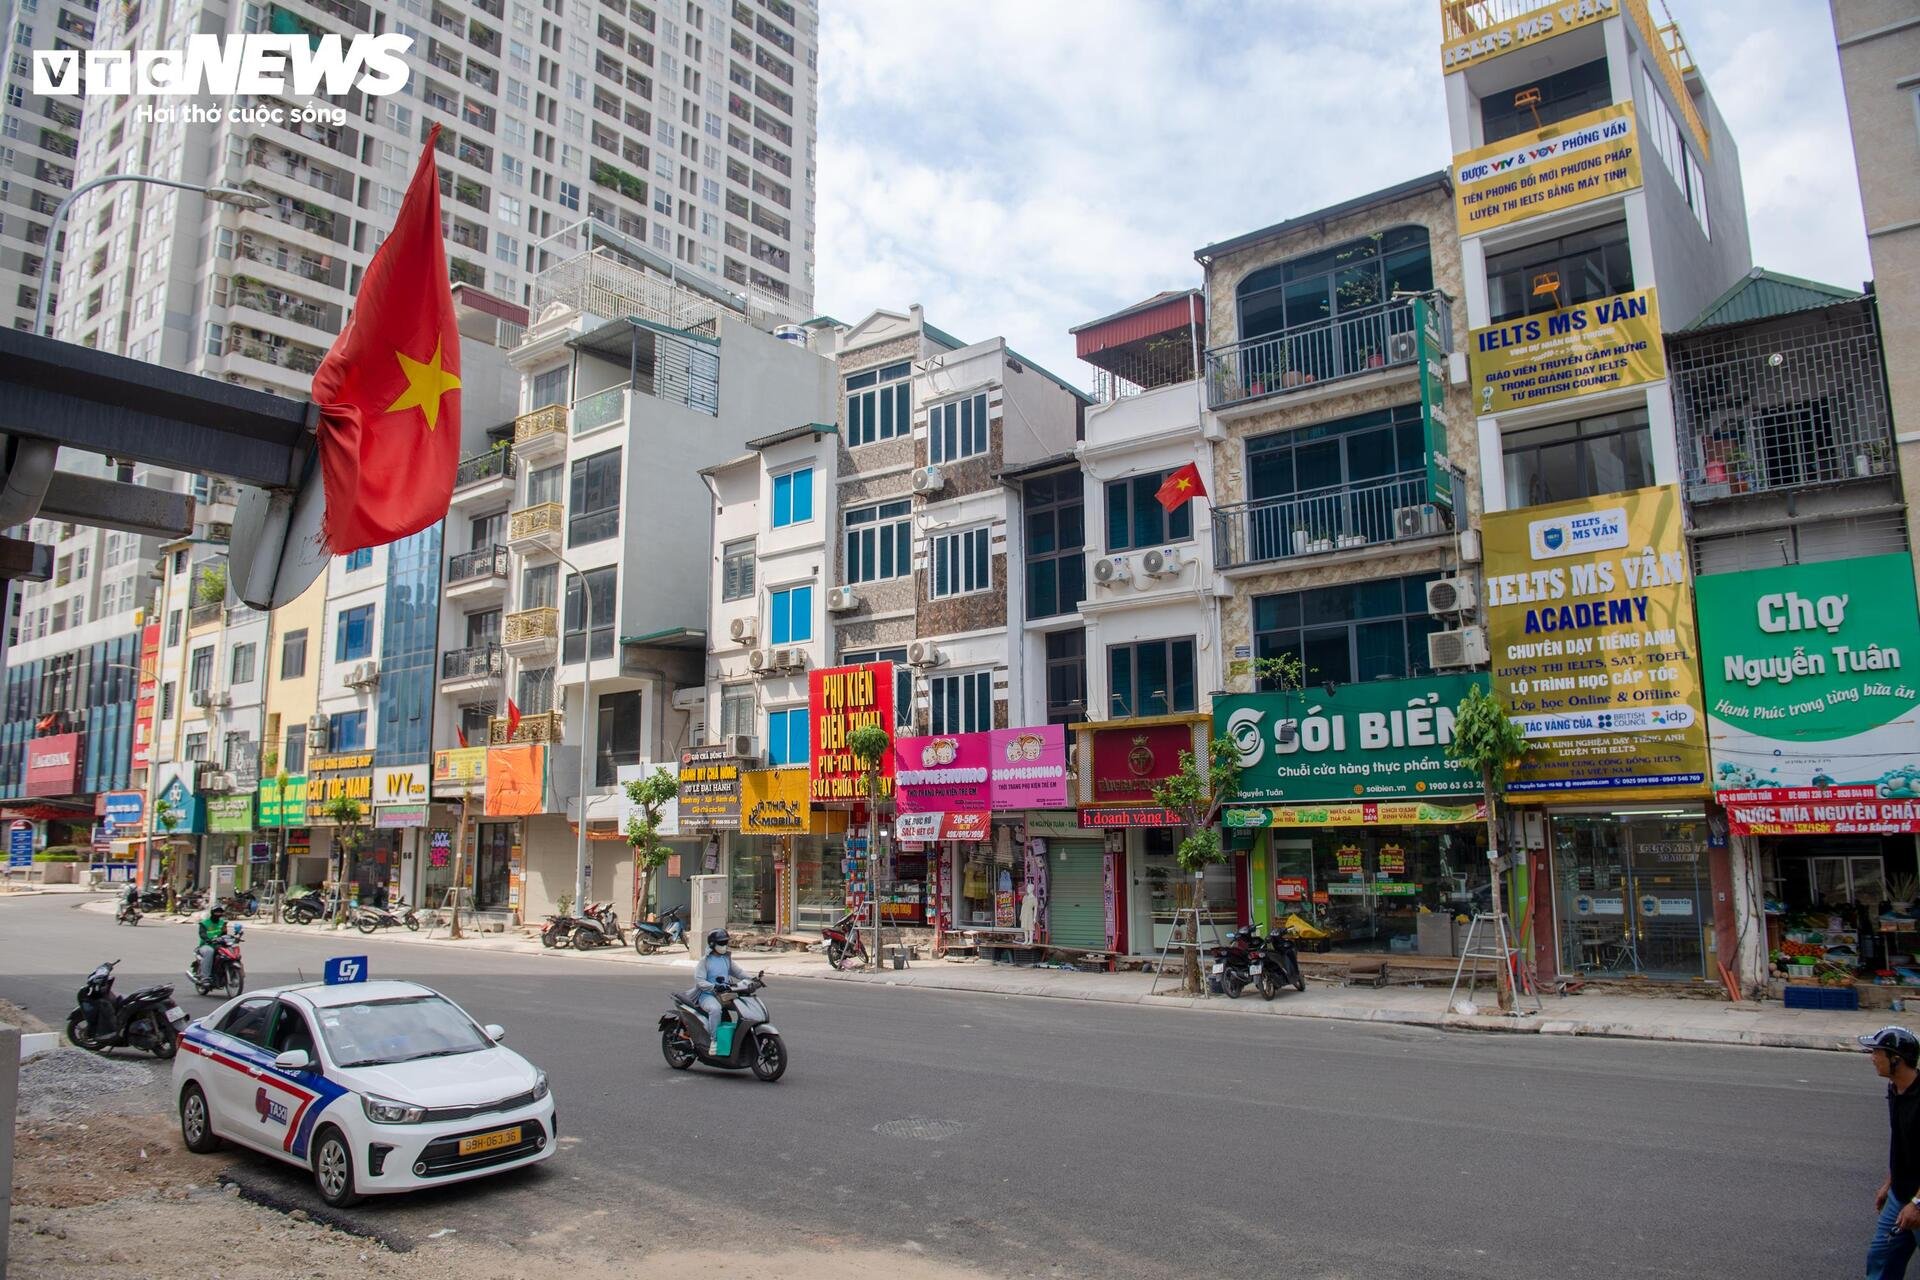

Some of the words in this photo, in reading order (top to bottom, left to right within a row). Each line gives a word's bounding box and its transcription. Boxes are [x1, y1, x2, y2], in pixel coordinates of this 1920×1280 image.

[1444, 28, 1512, 67] IELTS
[1516, 13, 1553, 42] MS
[1461, 166, 1488, 182] ĐƯỢC
[1485, 181, 1518, 200] PHONG
[1561, 156, 1602, 178] PHƯƠNG
[1604, 147, 1632, 164] PHÁP
[1470, 203, 1500, 221] LUYỆN
[1502, 198, 1518, 210] THI
[1520, 193, 1545, 206] IELTS
[1478, 320, 1541, 353] IELTS
[1548, 309, 1587, 337] MS
[1595, 296, 1647, 325] VÂN
[1501, 379, 1536, 392] TRONG
[1599, 359, 1628, 372] IELTS
[1528, 384, 1570, 398] BRITISH
[1573, 372, 1621, 391] COUNCIL
[1571, 517, 1601, 529] IELTS
[1573, 530, 1590, 541] MS
[1593, 523, 1618, 540] VÂN
[1487, 567, 1565, 607] IELTS
[1570, 561, 1615, 598] MS
[1621, 545, 1684, 590] VÂN
[1525, 596, 1649, 635] ACADEMY
[1757, 592, 1849, 634] Chợ
[1508, 639, 1563, 660] CHUYÊN
[1566, 638, 1594, 659] DẠY
[1597, 630, 1640, 654] TIẾNG
[1644, 628, 1676, 646] ANH
[1498, 665, 1537, 678] LUYỆN
[1542, 662, 1563, 673] THI
[1647, 650, 1690, 663] TOEFL
[1723, 646, 1826, 687] Nguyễn
[1831, 643, 1901, 674] Tuân
[823, 673, 846, 714] PHỤ
[847, 663, 875, 712] KIỆN
[1511, 680, 1529, 695] LỘ
[1532, 676, 1575, 692] TRÌNH
[1578, 673, 1609, 690] HỌC
[1612, 665, 1644, 686] CẤP
[1648, 666, 1679, 682] TỐC
[1511, 699, 1536, 711] Lớp
[1541, 697, 1564, 709] học
[1569, 694, 1612, 707] Online
[1617, 691, 1629, 702] &
[1632, 688, 1681, 701] Offline
[1714, 699, 1750, 720] Hạnh
[1753, 704, 1786, 720] Phúc
[1788, 698, 1826, 717] trong
[1827, 687, 1859, 706] từng
[1863, 681, 1891, 697] bữa
[1894, 684, 1916, 700] ăn
[820, 707, 846, 755] ĐIỆN
[1274, 703, 1346, 755] SÓI
[1545, 718, 1571, 732] VÀNG
[1613, 711, 1646, 721] BRITISH
[1665, 709, 1687, 723] idp
[1613, 718, 1647, 727] COUNCIL
[1552, 740, 1574, 748] KINH
[1664, 733, 1685, 742] ANH
[1590, 745, 1609, 754] THI
[1609, 744, 1636, 753] IELTS
[1277, 760, 1310, 777] Chuỗi
[1313, 761, 1336, 776] cửa
[1338, 761, 1370, 777] hàng
[1372, 759, 1402, 776] thực
[1403, 755, 1440, 774] phẩm
[1612, 766, 1633, 774] NAM
[307, 771, 325, 801] CẮT
[327, 773, 345, 800] TÓC
[346, 776, 371, 799] NAM
[387, 773, 413, 797] IVY
[701, 783, 712, 793] ĐẠI
[713, 781, 731, 792] HÀNH
[812, 773, 831, 797] SỬA
[832, 773, 854, 797] CHỮA
[919, 788, 934, 797] TRANG
[969, 787, 977, 796] EM
[1022, 783, 1030, 791] PHỤ
[1050, 780, 1057, 788] EM
[1265, 788, 1283, 797] Tuân
[1429, 781, 1448, 791] 1900
[1449, 781, 1462, 790] 63
[1463, 781, 1474, 790] 63
[1736, 791, 1759, 801] NGUYỄN
[1094, 811, 1131, 824] doanh
[1133, 810, 1162, 826] vàng
[1735, 806, 1776, 824] NƯỚC
[1779, 803, 1811, 822] MÍA
[1814, 802, 1877, 821] NGUYÊN
[434, 832, 448, 841] IVY
[1858, 823, 1868, 832] to
[431, 840, 450, 848] HAIR
[339, 959, 360, 981] G7
[269, 1101, 289, 1121] TAXI
